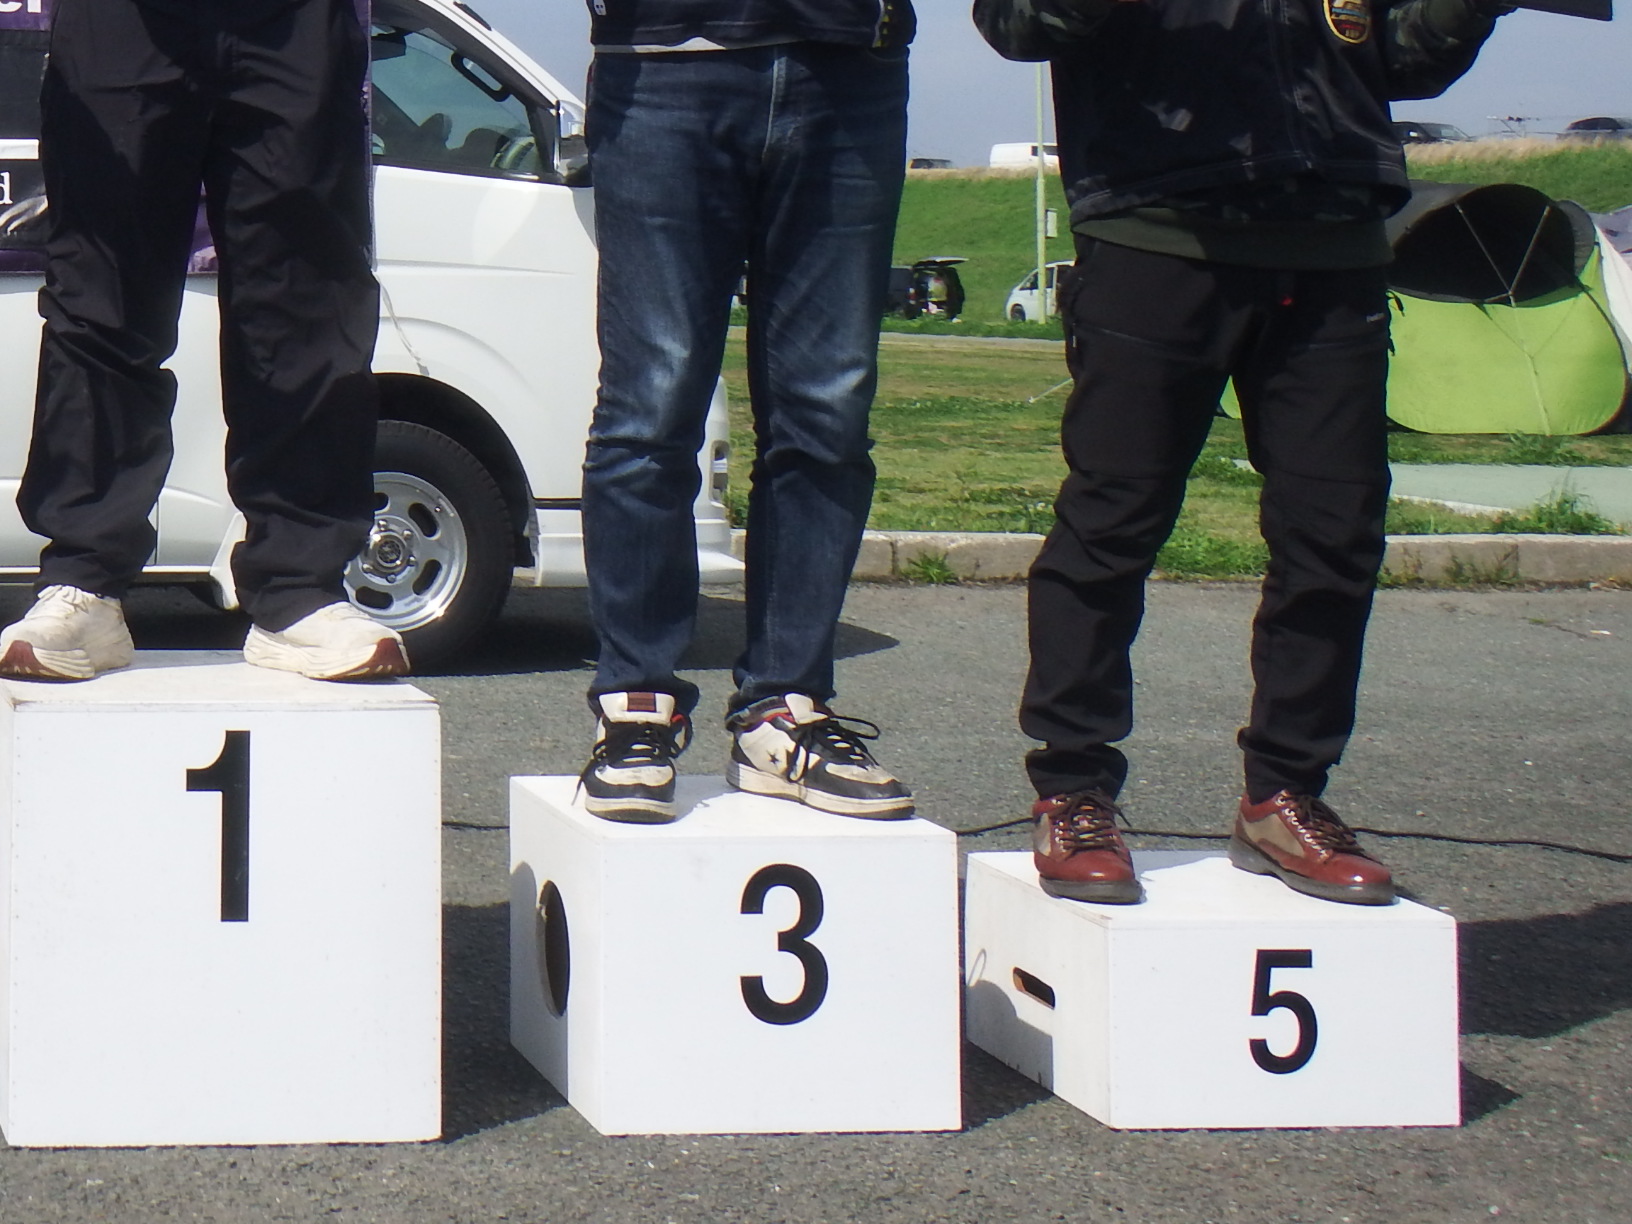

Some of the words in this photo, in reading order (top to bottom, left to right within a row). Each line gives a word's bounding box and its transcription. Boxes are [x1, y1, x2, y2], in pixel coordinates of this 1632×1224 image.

[186, 729, 252, 923] 1
[739, 863, 829, 1026] 3
[1248, 948, 1319, 1074] 5
